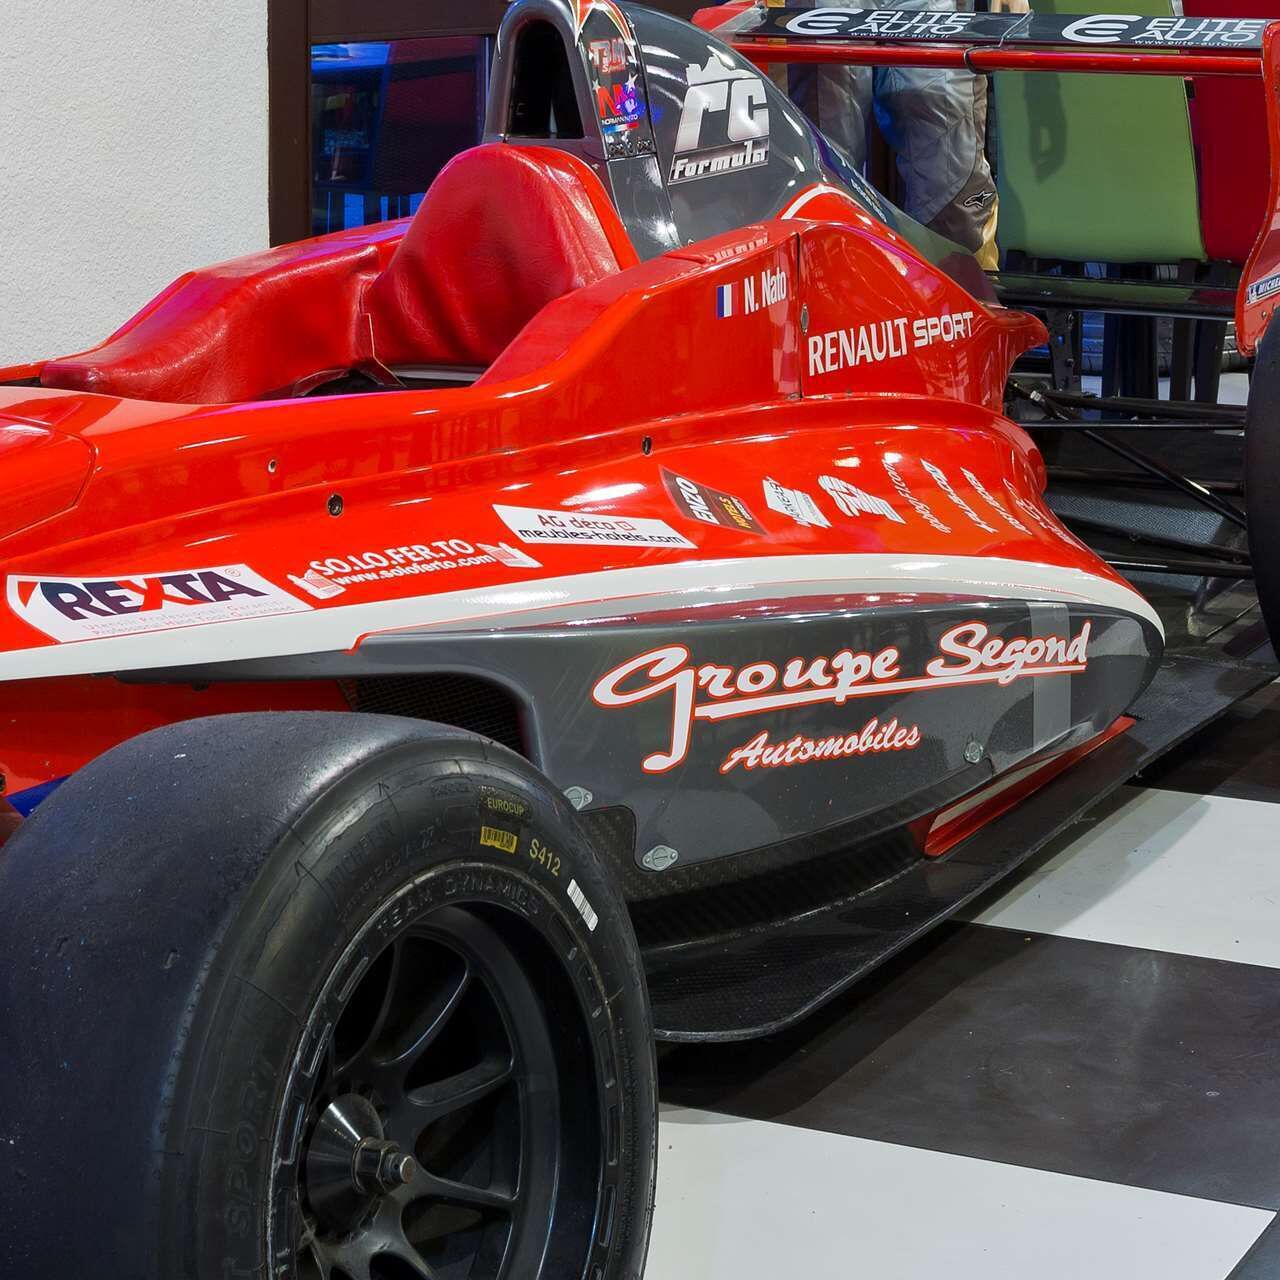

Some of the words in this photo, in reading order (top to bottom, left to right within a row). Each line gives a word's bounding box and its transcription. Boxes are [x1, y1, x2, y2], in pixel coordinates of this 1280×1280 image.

[848, 23, 965, 34] AUTO
[865, 11, 976, 25] ELITE
[1145, 18, 1266, 32] ELITE
[1130, 30, 1256, 42] AUTO
[673, 141, 768, 179] Formula
[744, 277, 759, 315] N.
[762, 267, 788, 308] Nato
[808, 317, 908, 376] RENAULT
[913, 312, 974, 348] SPORT
[675, 477, 720, 525] ENZO
[719, 496, 753, 529] HOTELS
[518, 528, 688, 545] meubles-hotels.com
[537, 514, 565, 527] AG
[569, 515, 613, 531] déco
[310, 538, 475, 577] SO.LO.FER.TO
[332, 554, 496, 586] www.soloferto.com
[40, 571, 270, 620] REXTA
[593, 644, 900, 772] Groupe
[927, 620, 1091, 688] Segond
[721, 718, 920, 773] Automobiles
[487, 797, 525, 816] EUROCUP
[529, 839, 561, 876] S412
